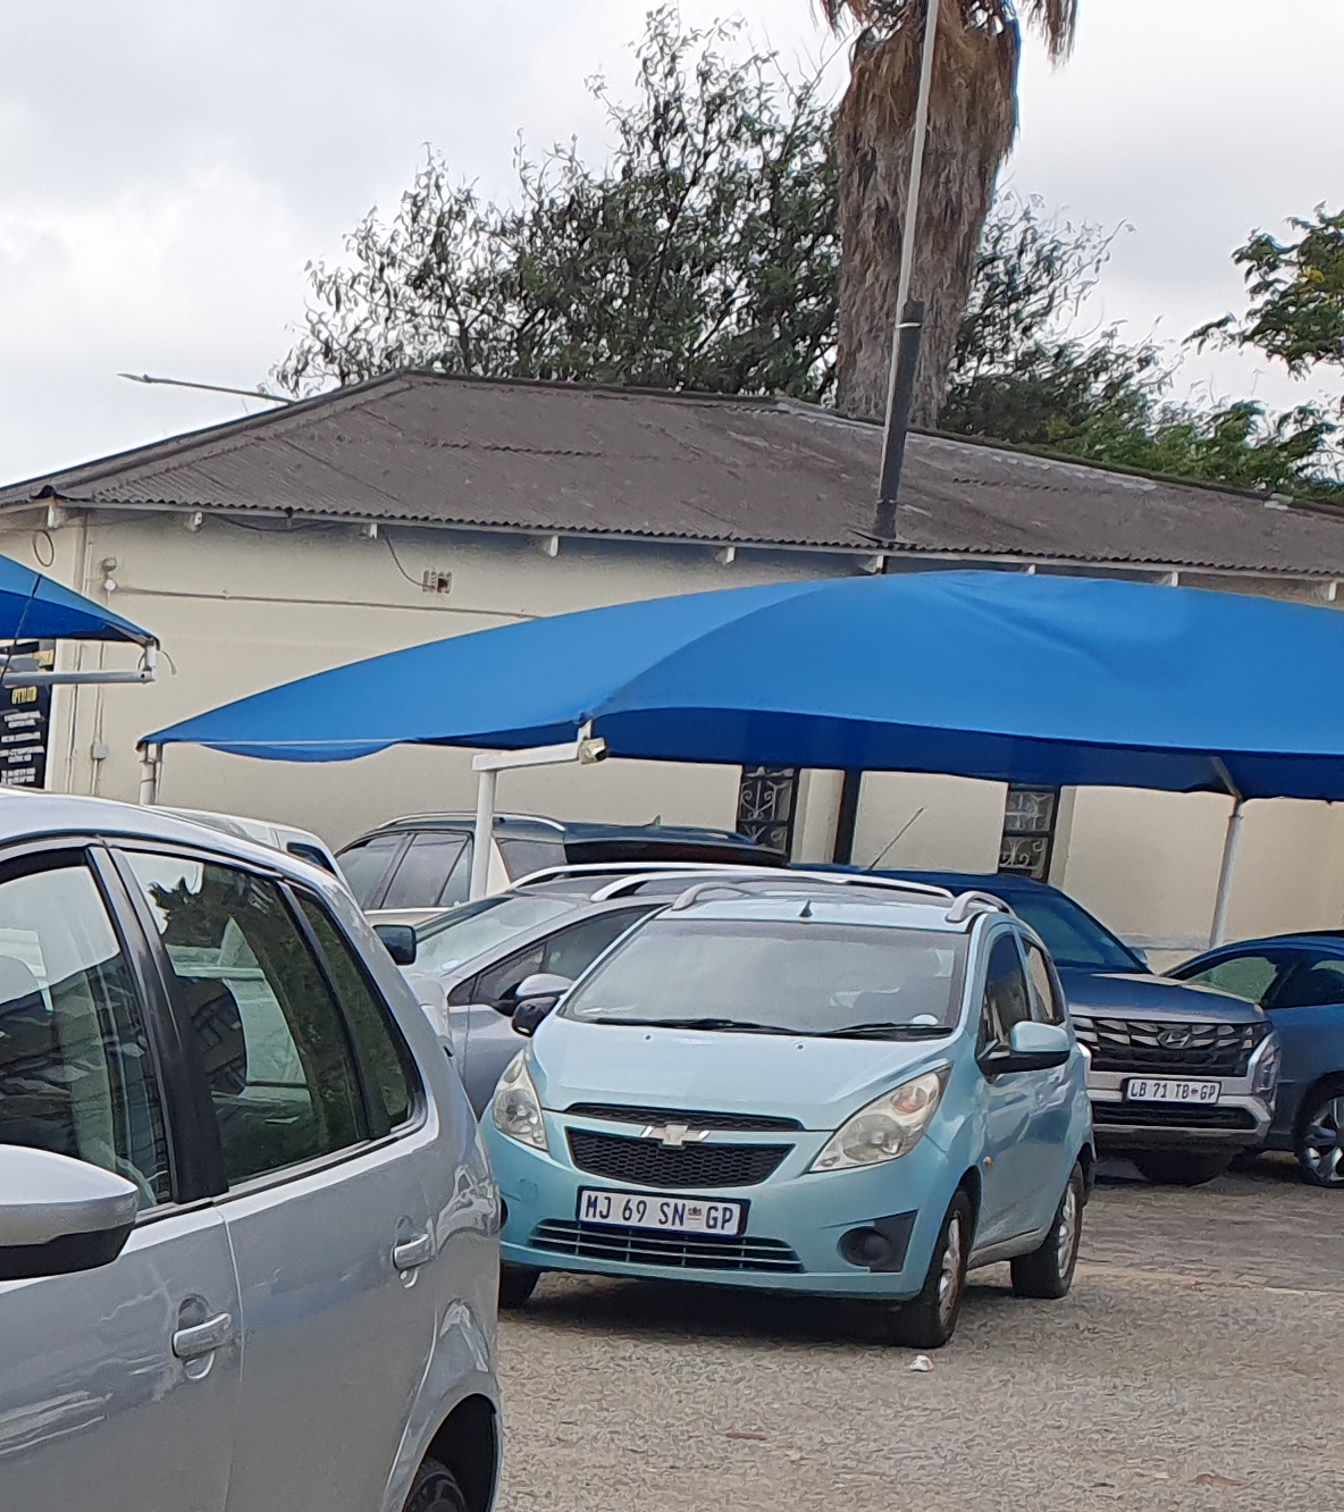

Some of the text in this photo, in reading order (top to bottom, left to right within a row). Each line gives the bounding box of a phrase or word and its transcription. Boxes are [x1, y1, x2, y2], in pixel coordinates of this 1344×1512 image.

[1200, 1085, 1216, 1101] GP
[585, 1194, 734, 1231] MJ 69 SN GP
